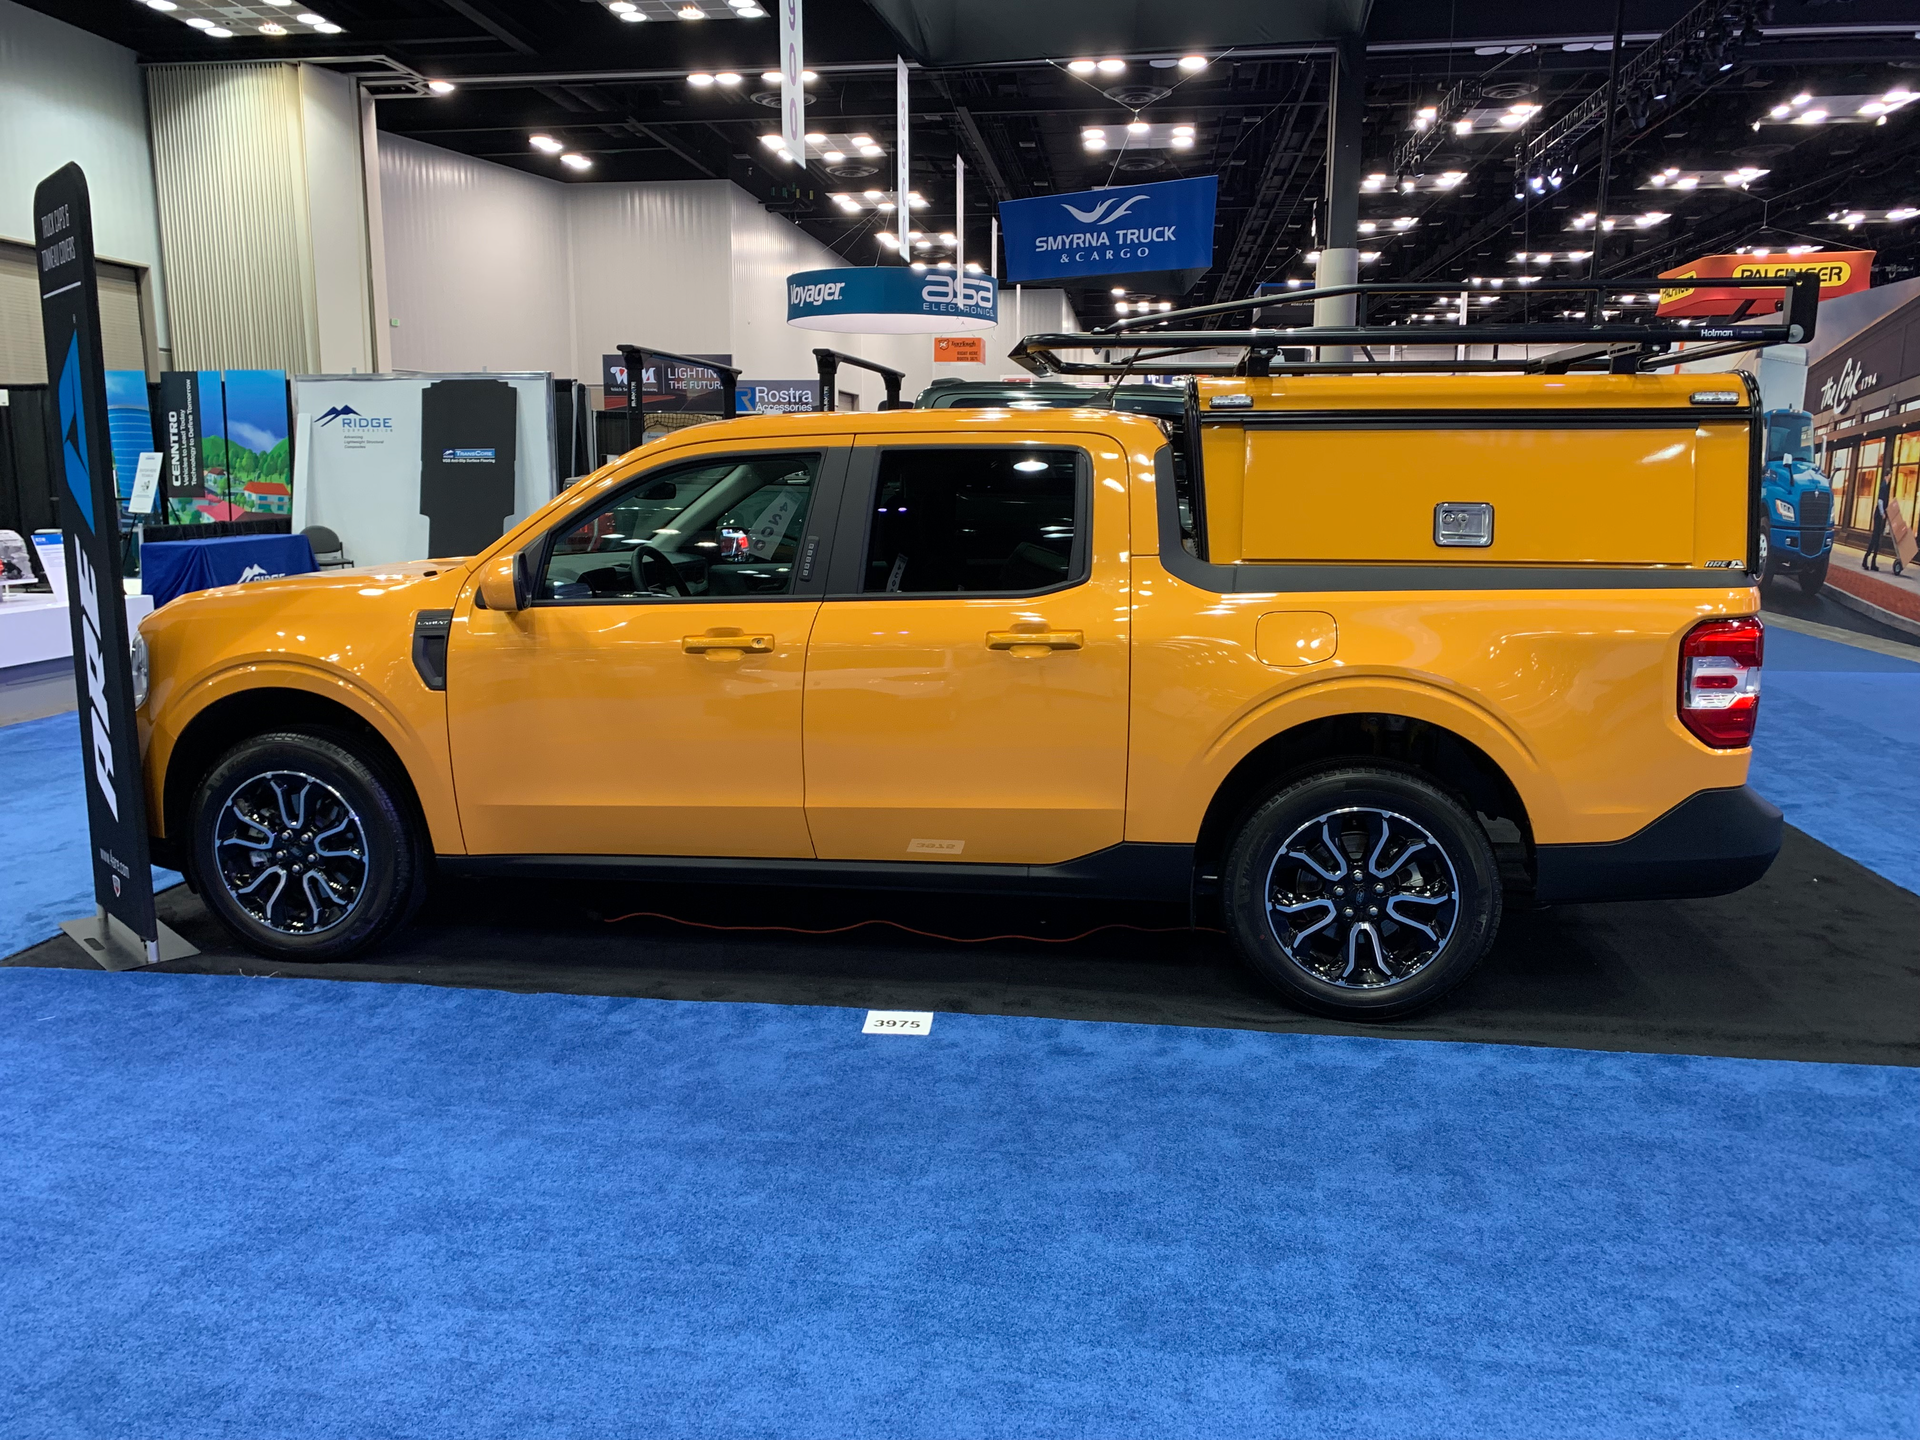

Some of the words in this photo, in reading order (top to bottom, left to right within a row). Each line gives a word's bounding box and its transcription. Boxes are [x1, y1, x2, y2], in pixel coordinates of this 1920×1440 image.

[1035, 231, 1110, 252] SMYRNA
[1115, 225, 1176, 245] TRUCK
[1060, 253, 1069, 263] &
[1074, 247, 1149, 262] CARGO
[790, 282, 845, 307] Voyager
[923, 302, 993, 316] ELECTRONICS
[1701, 328, 1733, 337] Holman
[667, 367, 717, 379] LIGHTIN
[669, 380, 687, 390] THE
[690, 380, 723, 390] FUTUR
[1821, 376, 1836, 410] the
[755, 386, 813, 402] Rostra
[755, 402, 813, 411] Accessories
[342, 418, 392, 428] RIDGE
[168, 411, 182, 487] CENNTRO
[181, 449, 188, 457] to
[182, 457, 190, 486] Vehicles
[189, 447, 197, 486] Technology
[74, 533, 118, 823] ARE
[873, 1019, 921, 1029] 3975
